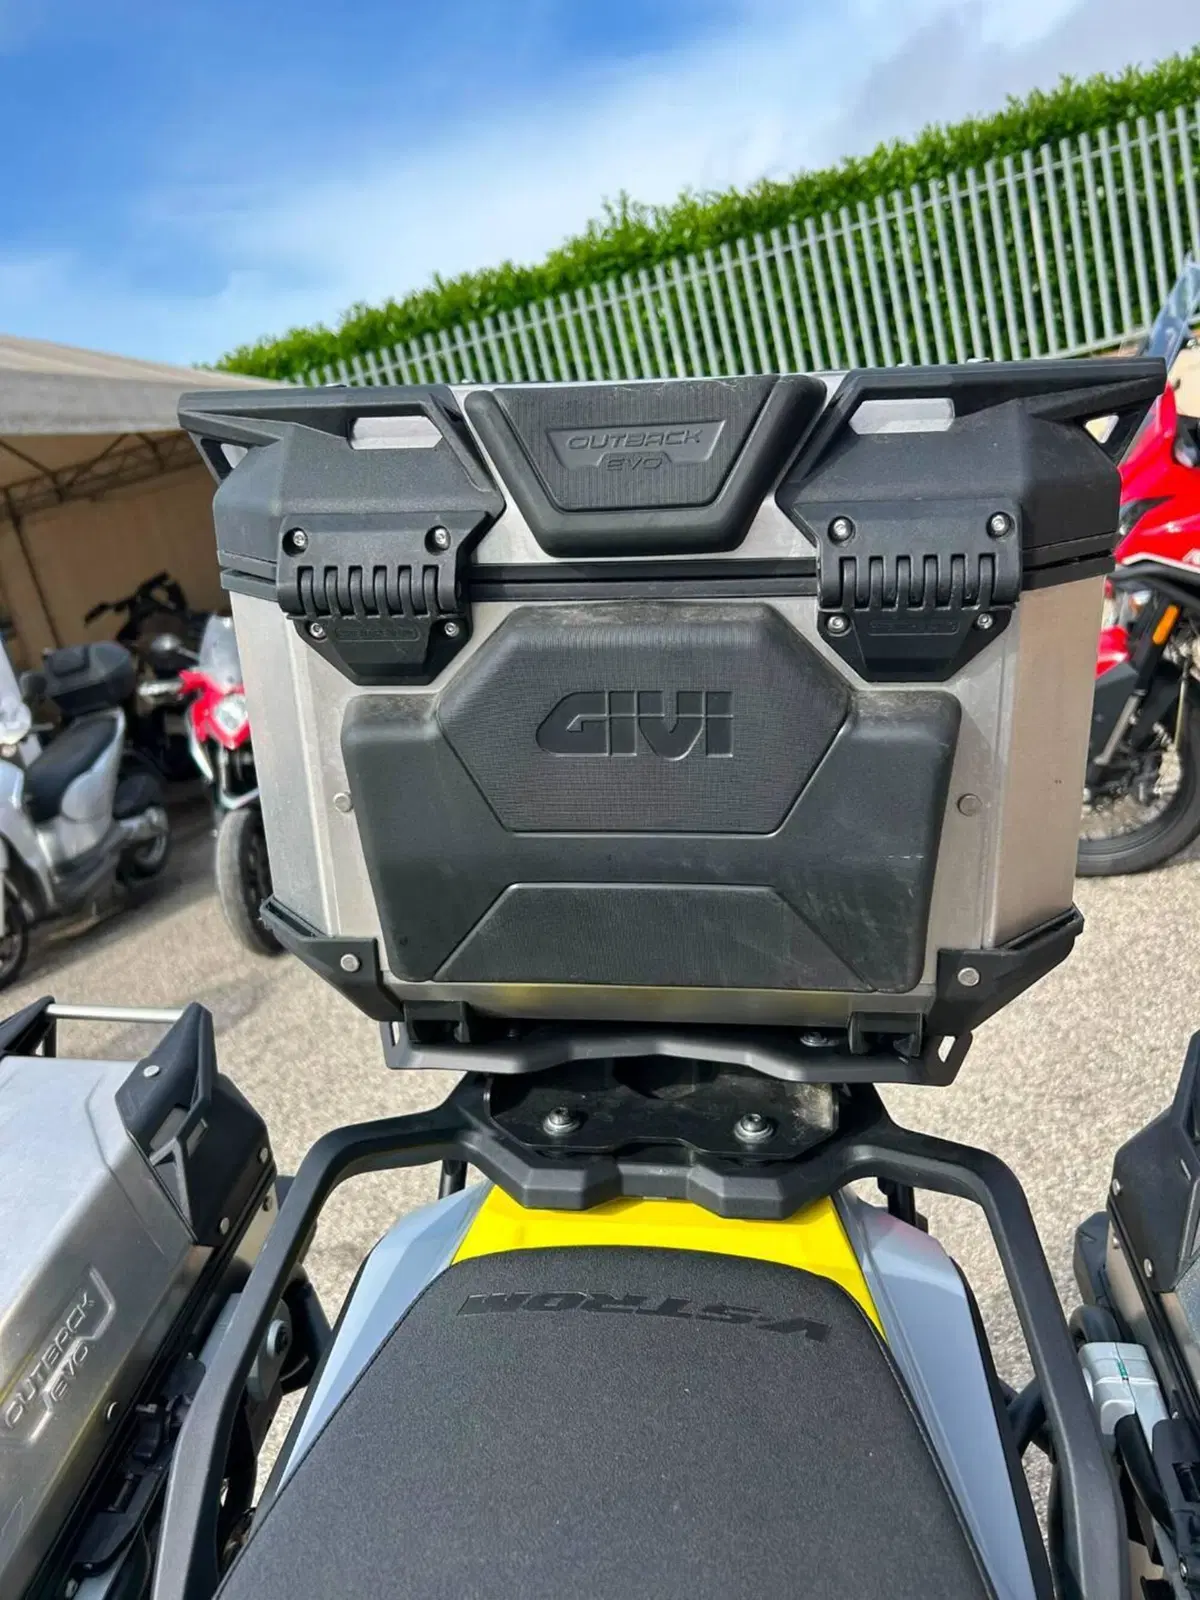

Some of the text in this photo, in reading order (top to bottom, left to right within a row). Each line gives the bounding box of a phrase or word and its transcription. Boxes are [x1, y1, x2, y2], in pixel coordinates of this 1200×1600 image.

[566, 429, 703, 450] OUTBACK
[607, 456, 664, 472] EVO
[535, 690, 735, 762] GIVI
